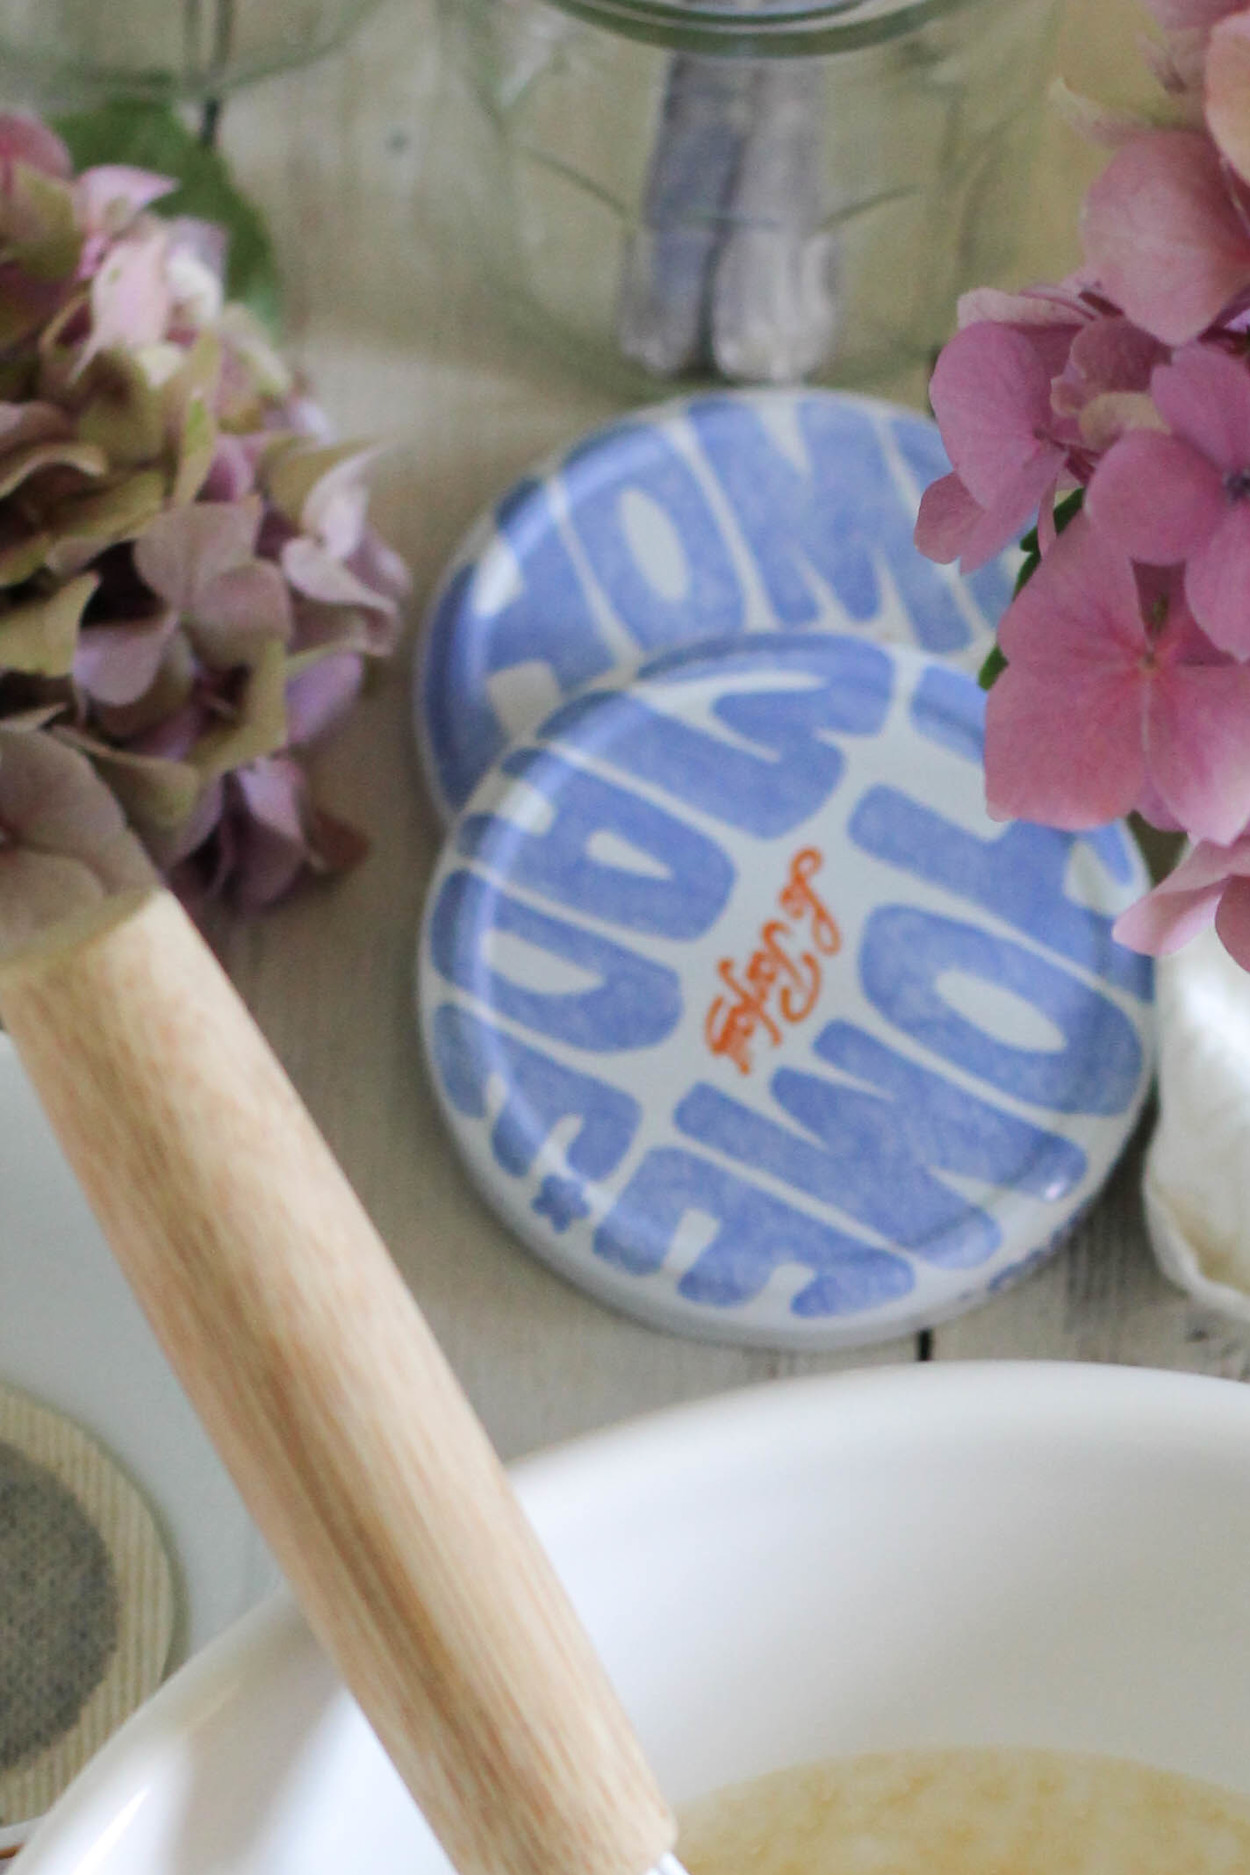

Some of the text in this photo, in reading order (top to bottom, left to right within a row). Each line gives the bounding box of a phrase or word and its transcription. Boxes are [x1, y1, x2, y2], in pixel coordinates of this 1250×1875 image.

[430, 632, 897, 1180] MADE
[592, 662, 1155, 1318] HOME
[779, 847, 841, 954] Le
